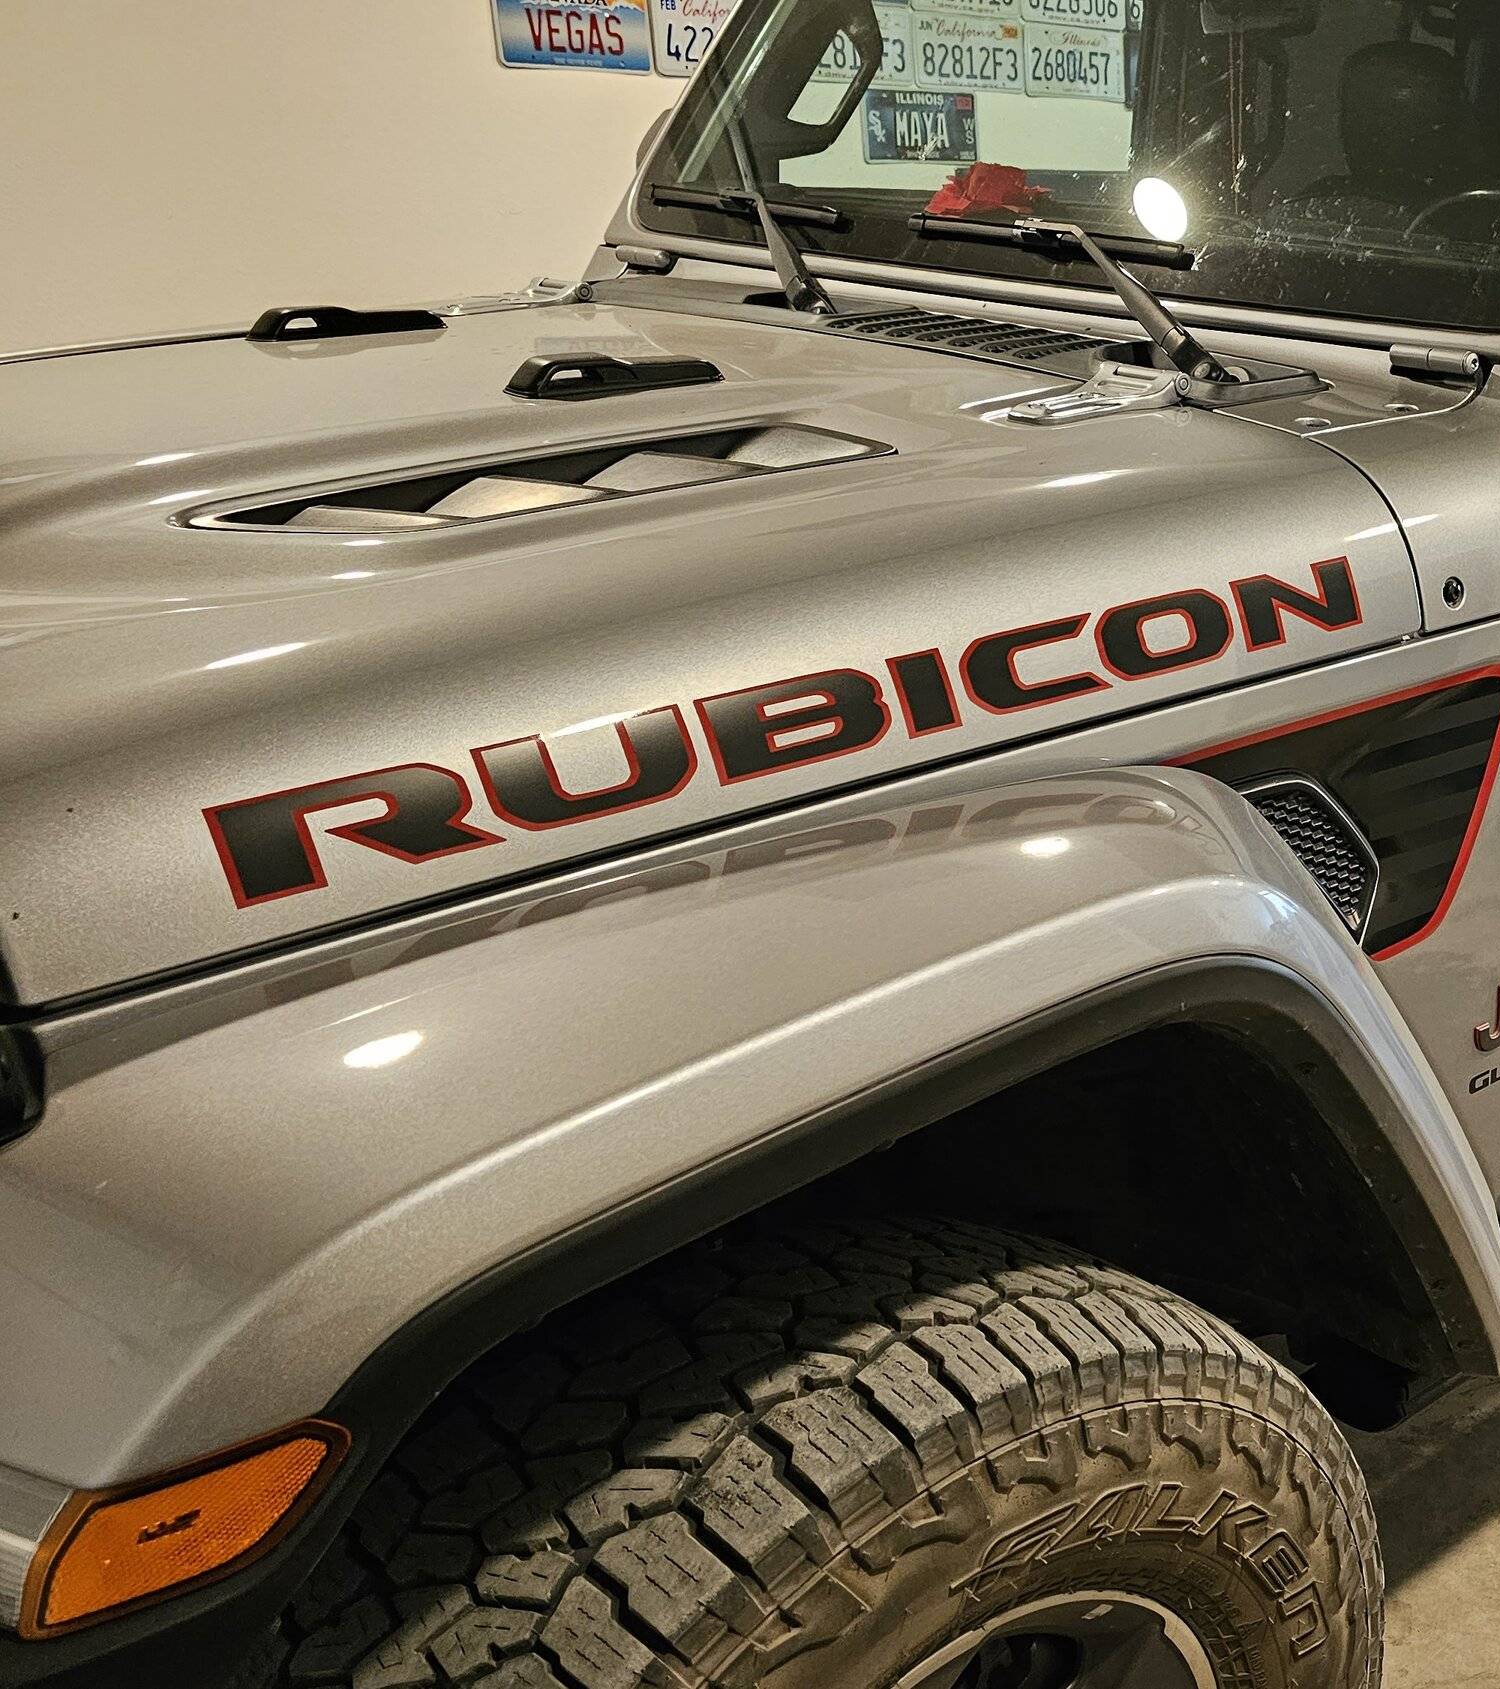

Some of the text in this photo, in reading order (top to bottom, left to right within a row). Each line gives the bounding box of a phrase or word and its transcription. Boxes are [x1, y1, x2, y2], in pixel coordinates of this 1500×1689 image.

[525, 7, 626, 57] VEGAS
[922, 41, 1018, 81] 82812F3
[1031, 46, 1111, 86] 2680457
[895, 92, 944, 106] ILLINOIS
[895, 111, 950, 149] MAYA
[201, 555, 1365, 910] RUBICON
[949, 1481, 1331, 1657] FALKEN
